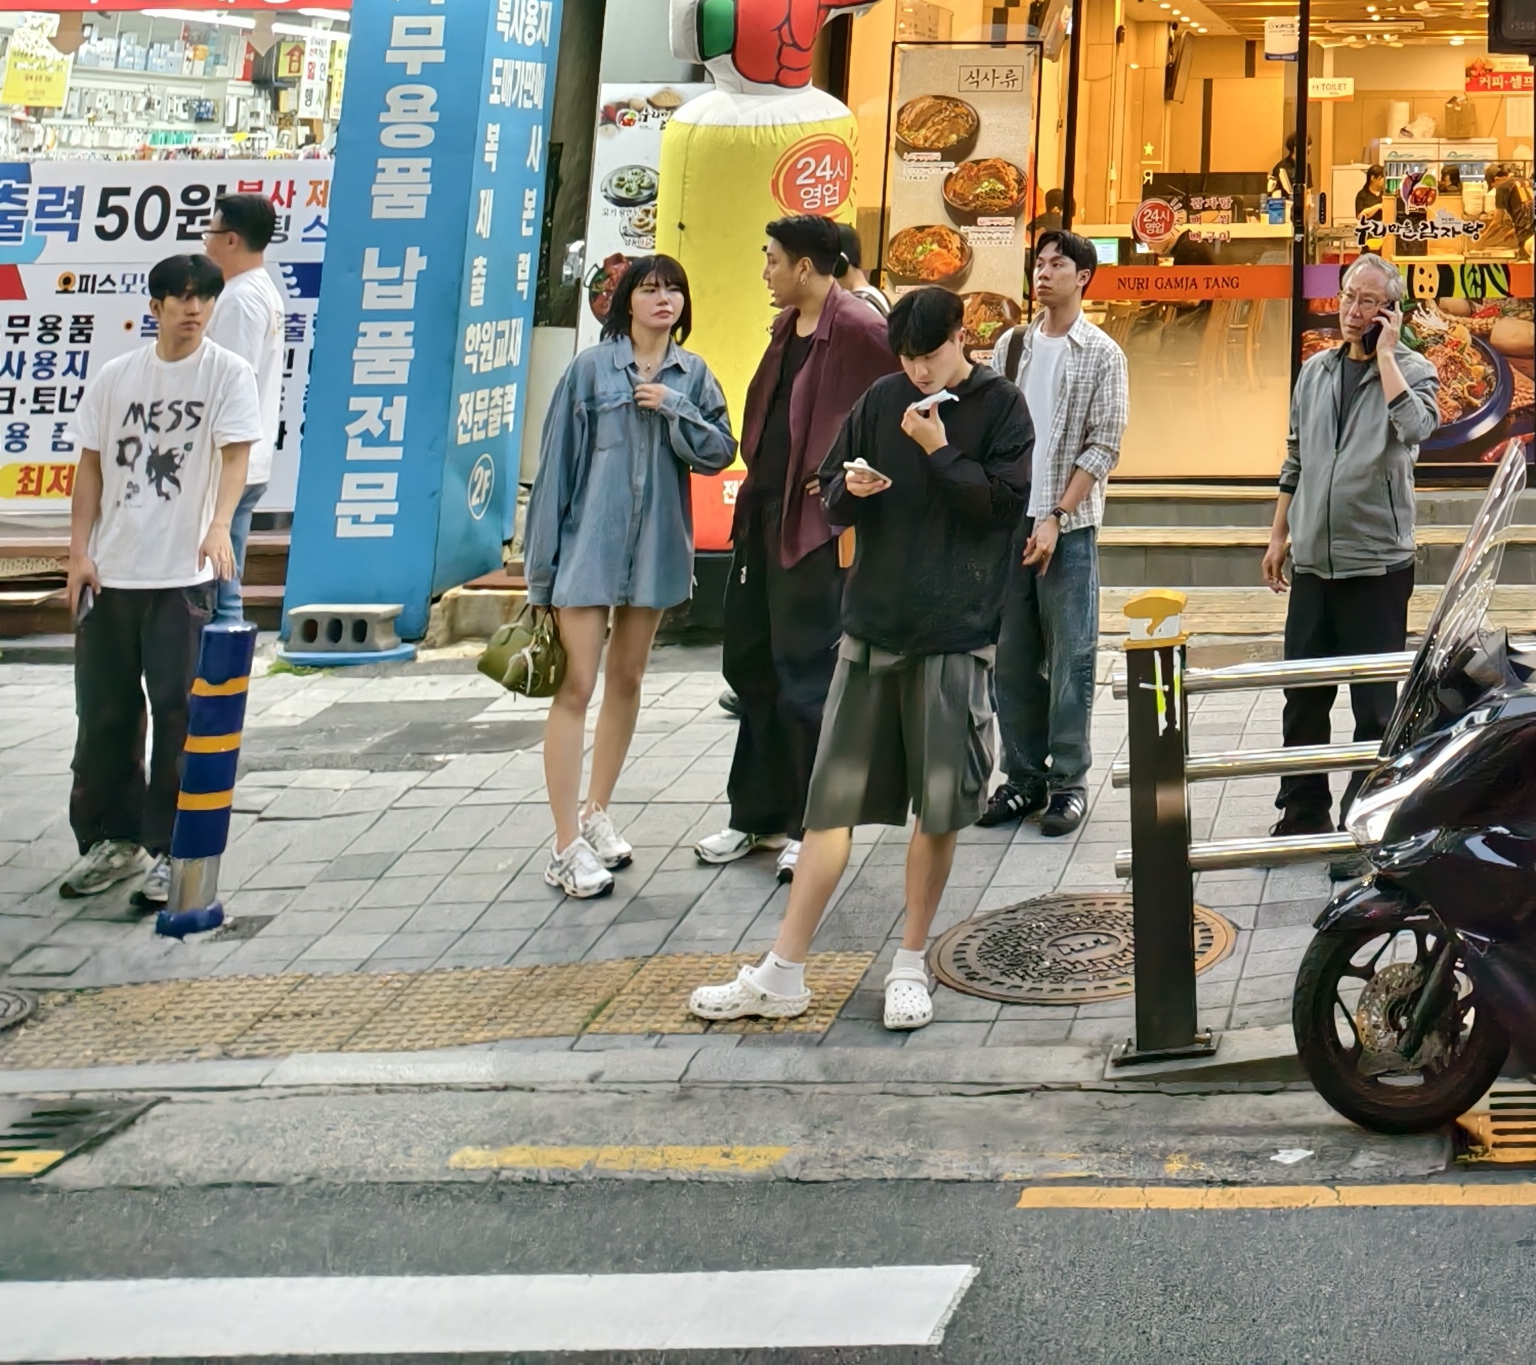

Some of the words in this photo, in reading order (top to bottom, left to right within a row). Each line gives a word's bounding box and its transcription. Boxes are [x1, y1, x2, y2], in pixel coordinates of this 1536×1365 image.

[964, 68, 1020, 90] 식사류
[1321, 83, 1348, 91] TOILET
[795, 155, 849, 184] 24시
[800, 182, 841, 210] 영업
[1142, 208, 1171, 223] 24시
[1116, 276, 1150, 291] NURI
[1154, 276, 1199, 291] GAMJA
[1203, 275, 1241, 290] TANG
[464, 316, 524, 375] 학원교재
[335, 246, 428, 539] 납품전문
[122, 398, 206, 435] MESS
[456, 382, 518, 446] 전문출력
[471, 465, 492, 508] 2F
